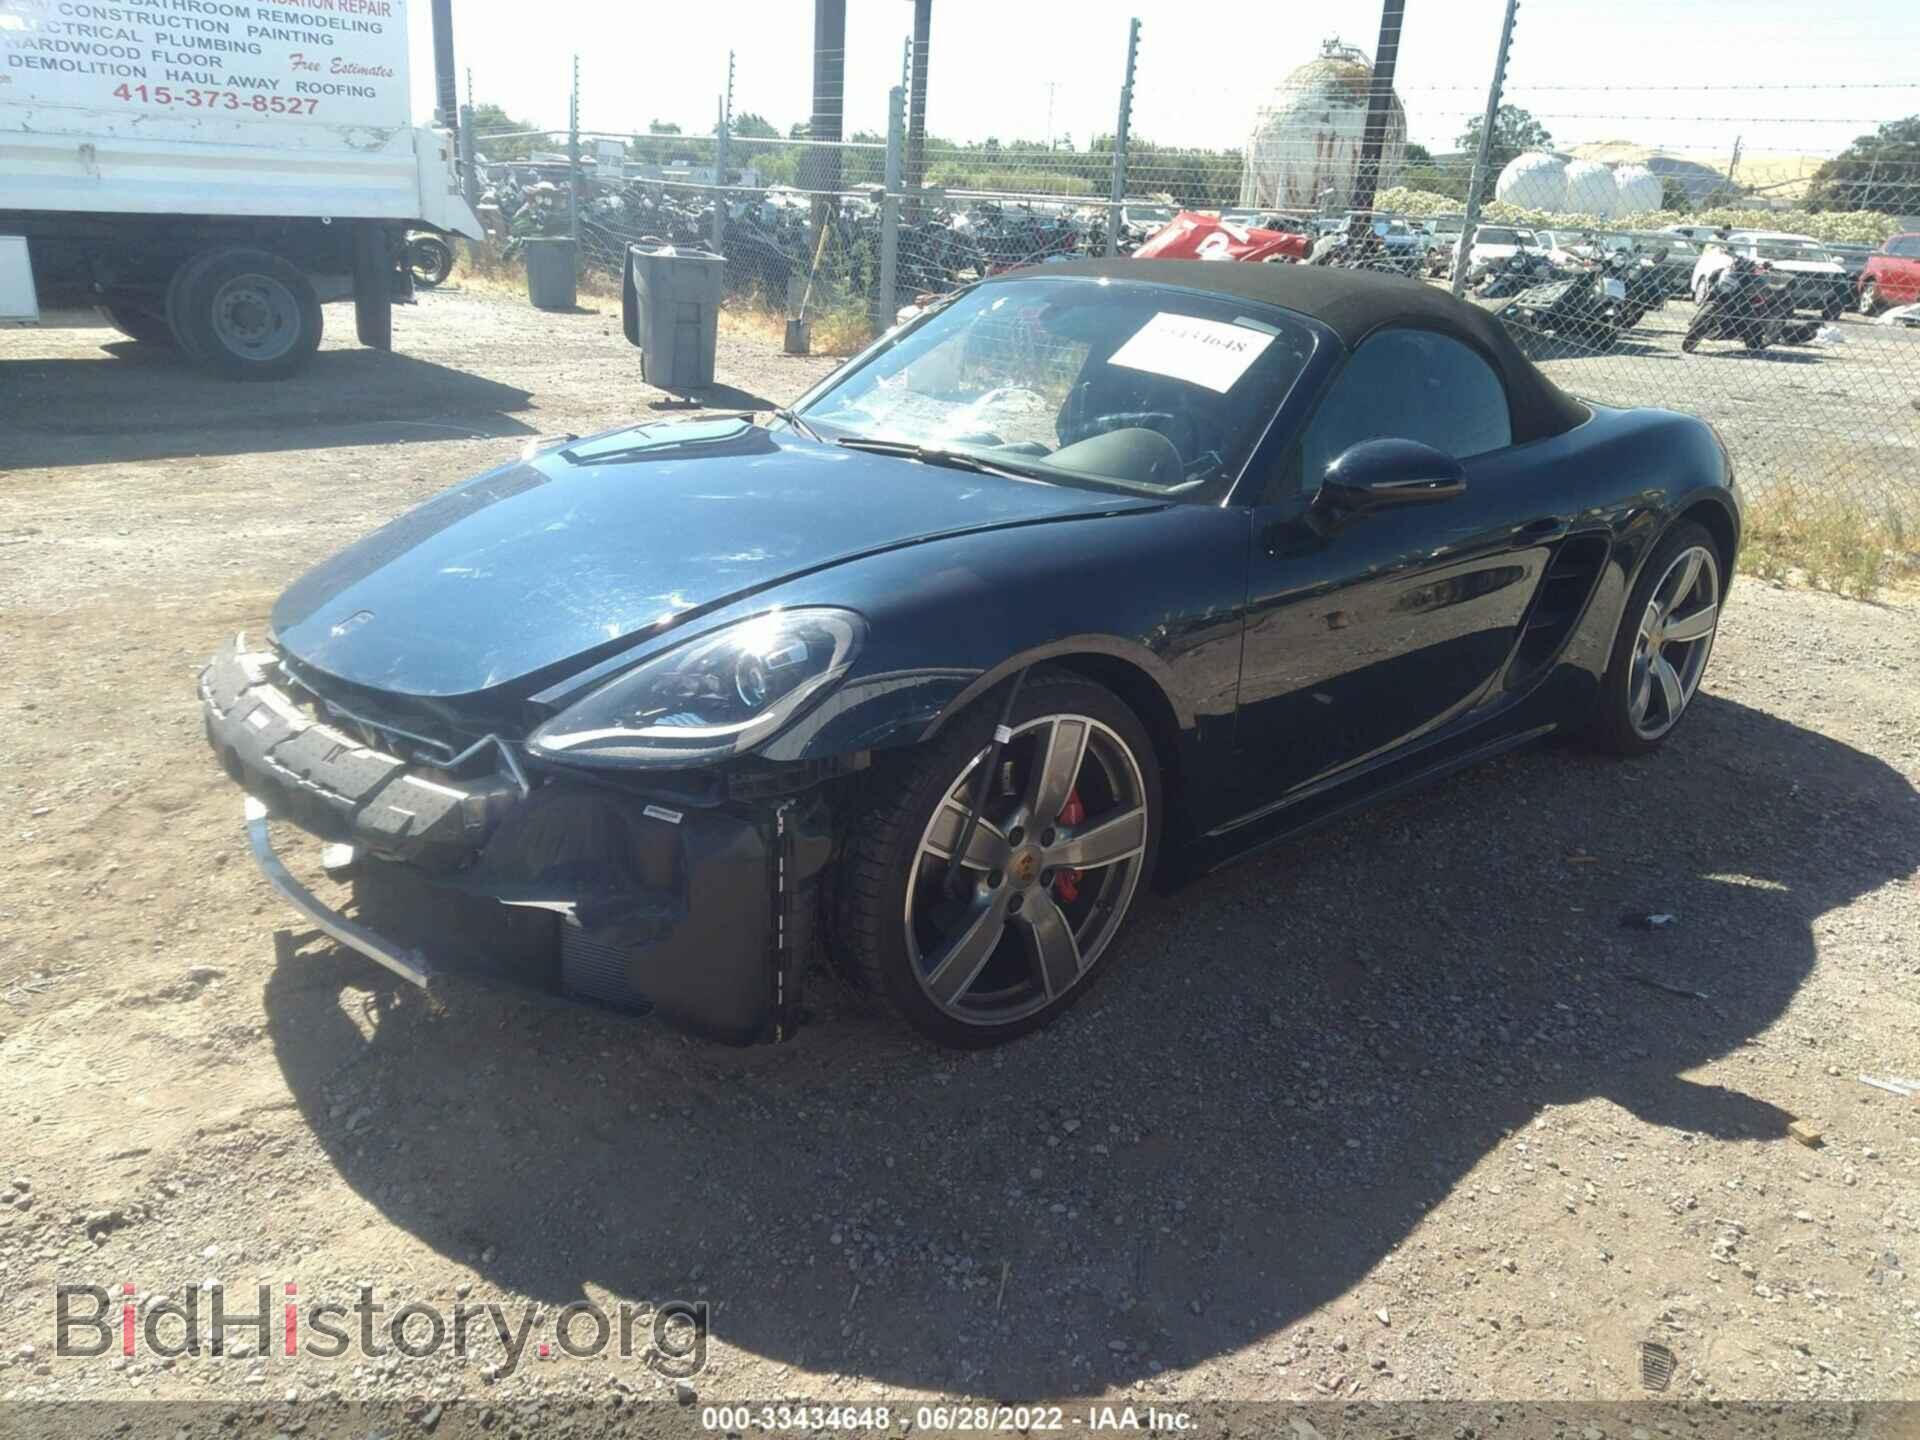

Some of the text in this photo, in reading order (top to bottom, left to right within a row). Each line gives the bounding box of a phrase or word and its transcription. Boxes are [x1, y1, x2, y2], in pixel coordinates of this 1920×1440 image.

[338, 0, 392, 18] REPAIR
[58, 3, 334, 46] CONSTRUCTION PAINTING
[257, 9, 383, 35] REMODELING
[155, 32, 262, 55] PLUMBING
[152, 50, 223, 69] FLOOR
[289, 53, 394, 78] Free Estimates
[8, 54, 147, 79] DEMOLITION
[166, 68, 221, 86] HAUL
[226, 74, 280, 91] AWAY
[296, 81, 376, 99] ROOFING
[113, 82, 319, 115] 415-373-8527
